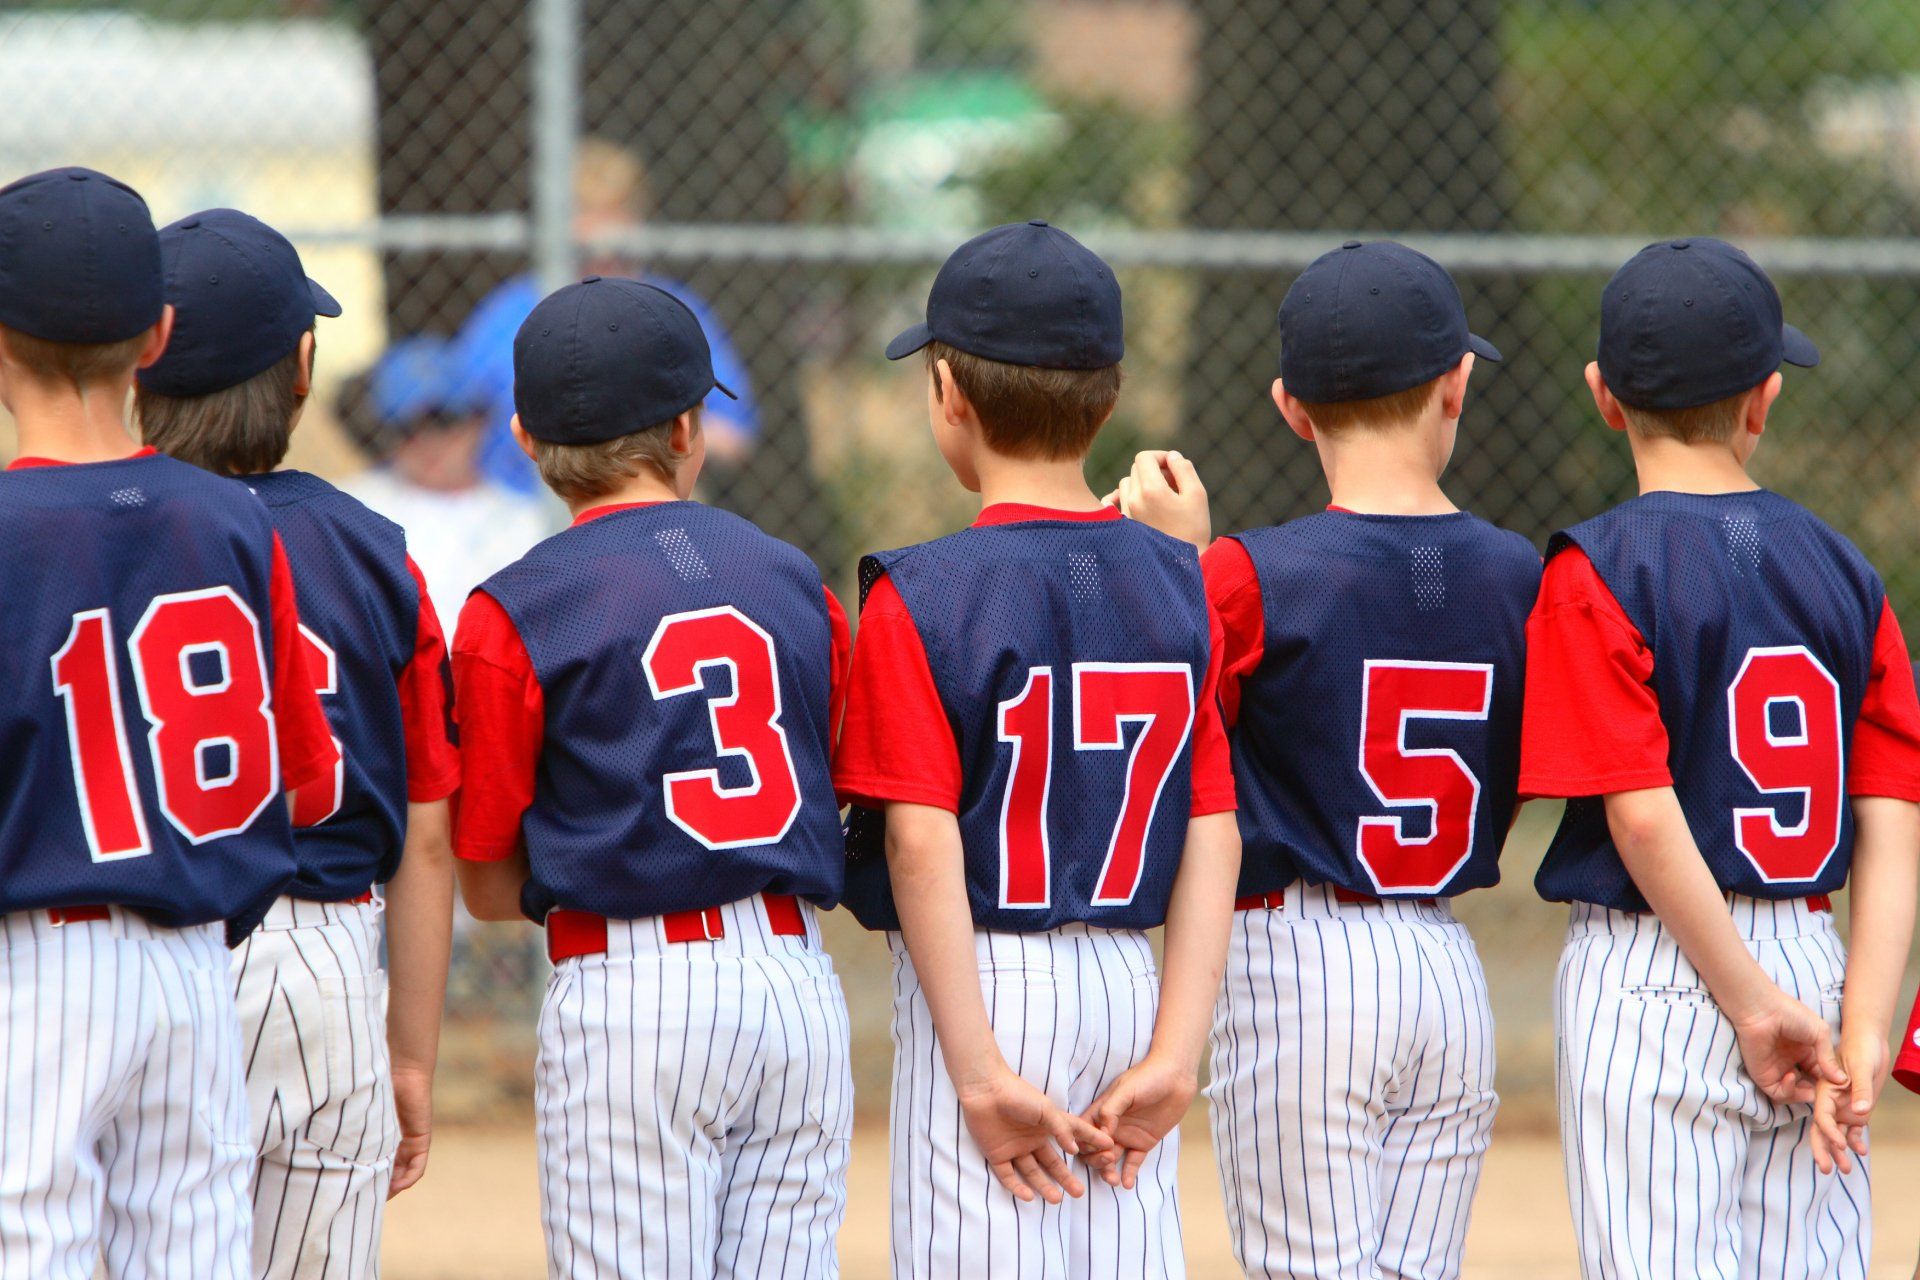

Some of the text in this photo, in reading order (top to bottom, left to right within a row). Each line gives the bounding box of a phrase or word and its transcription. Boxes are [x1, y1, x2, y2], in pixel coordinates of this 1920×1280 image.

[50, 585, 279, 863] 18
[641, 605, 802, 850] 3
[998, 662, 1195, 909] 17
[1357, 659, 1494, 894] 5
[1727, 645, 1844, 883] 9
